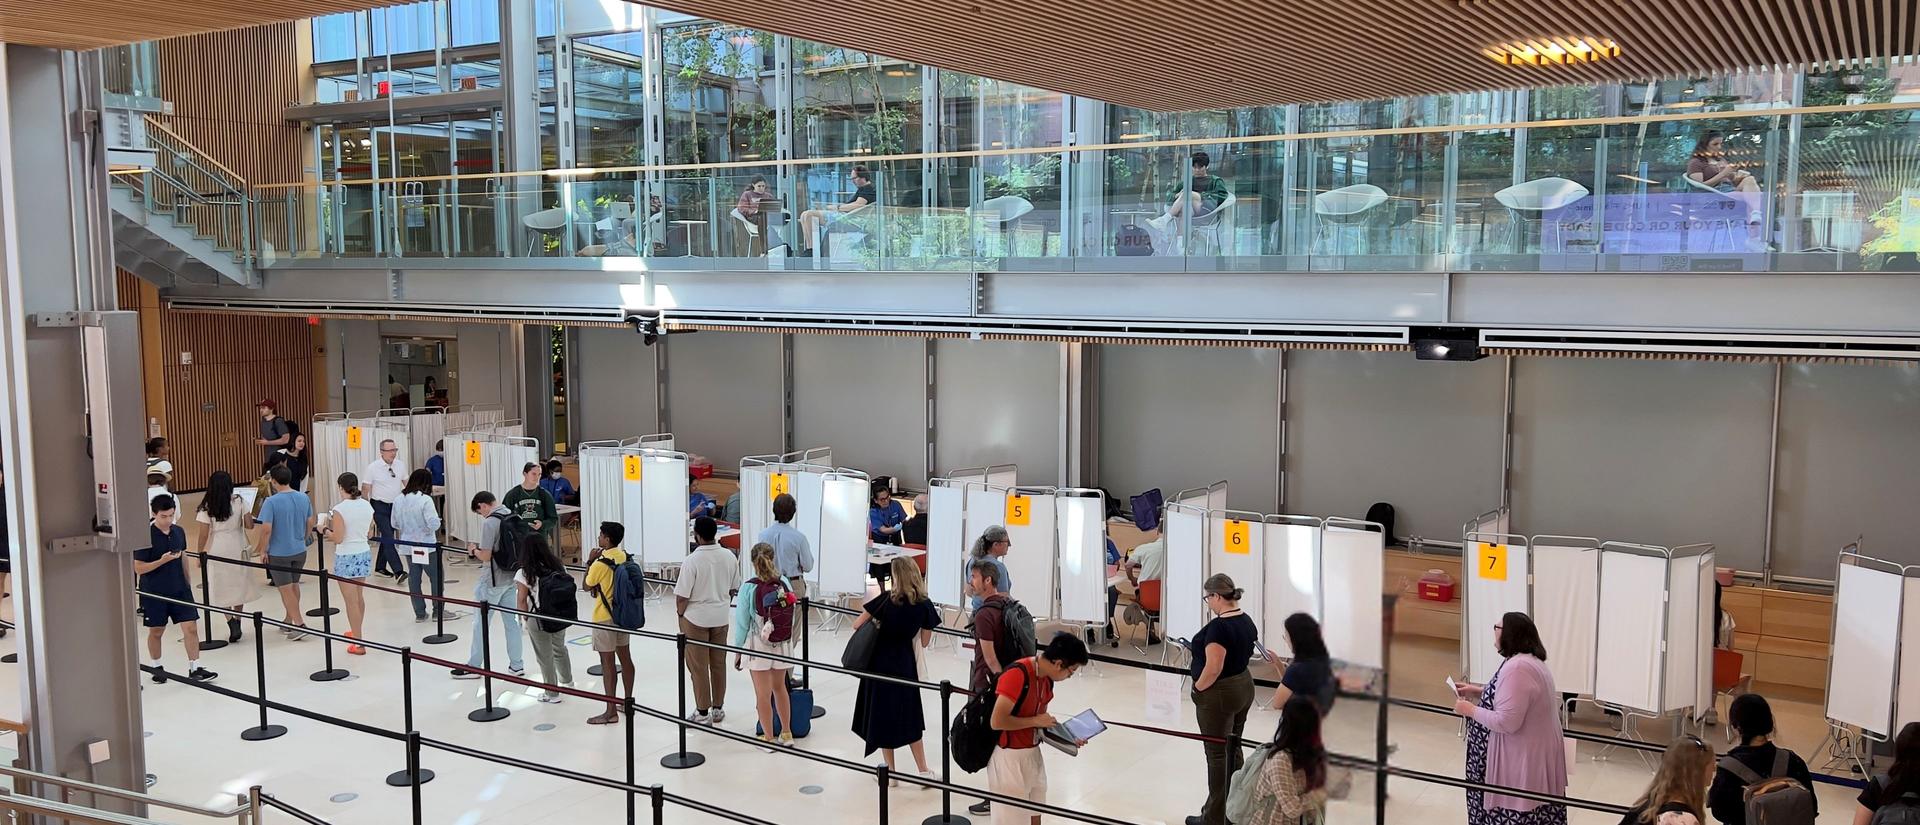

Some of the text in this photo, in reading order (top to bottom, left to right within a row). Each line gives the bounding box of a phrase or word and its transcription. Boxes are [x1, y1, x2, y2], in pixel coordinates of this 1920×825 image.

[352, 435, 357, 444] 1
[470, 449, 476, 459] 2
[629, 464, 635, 475] 3
[775, 483, 783, 493] 4
[1014, 505, 1022, 518] 5
[1232, 532, 1241, 545] 6
[1487, 556, 1497, 570] 7
